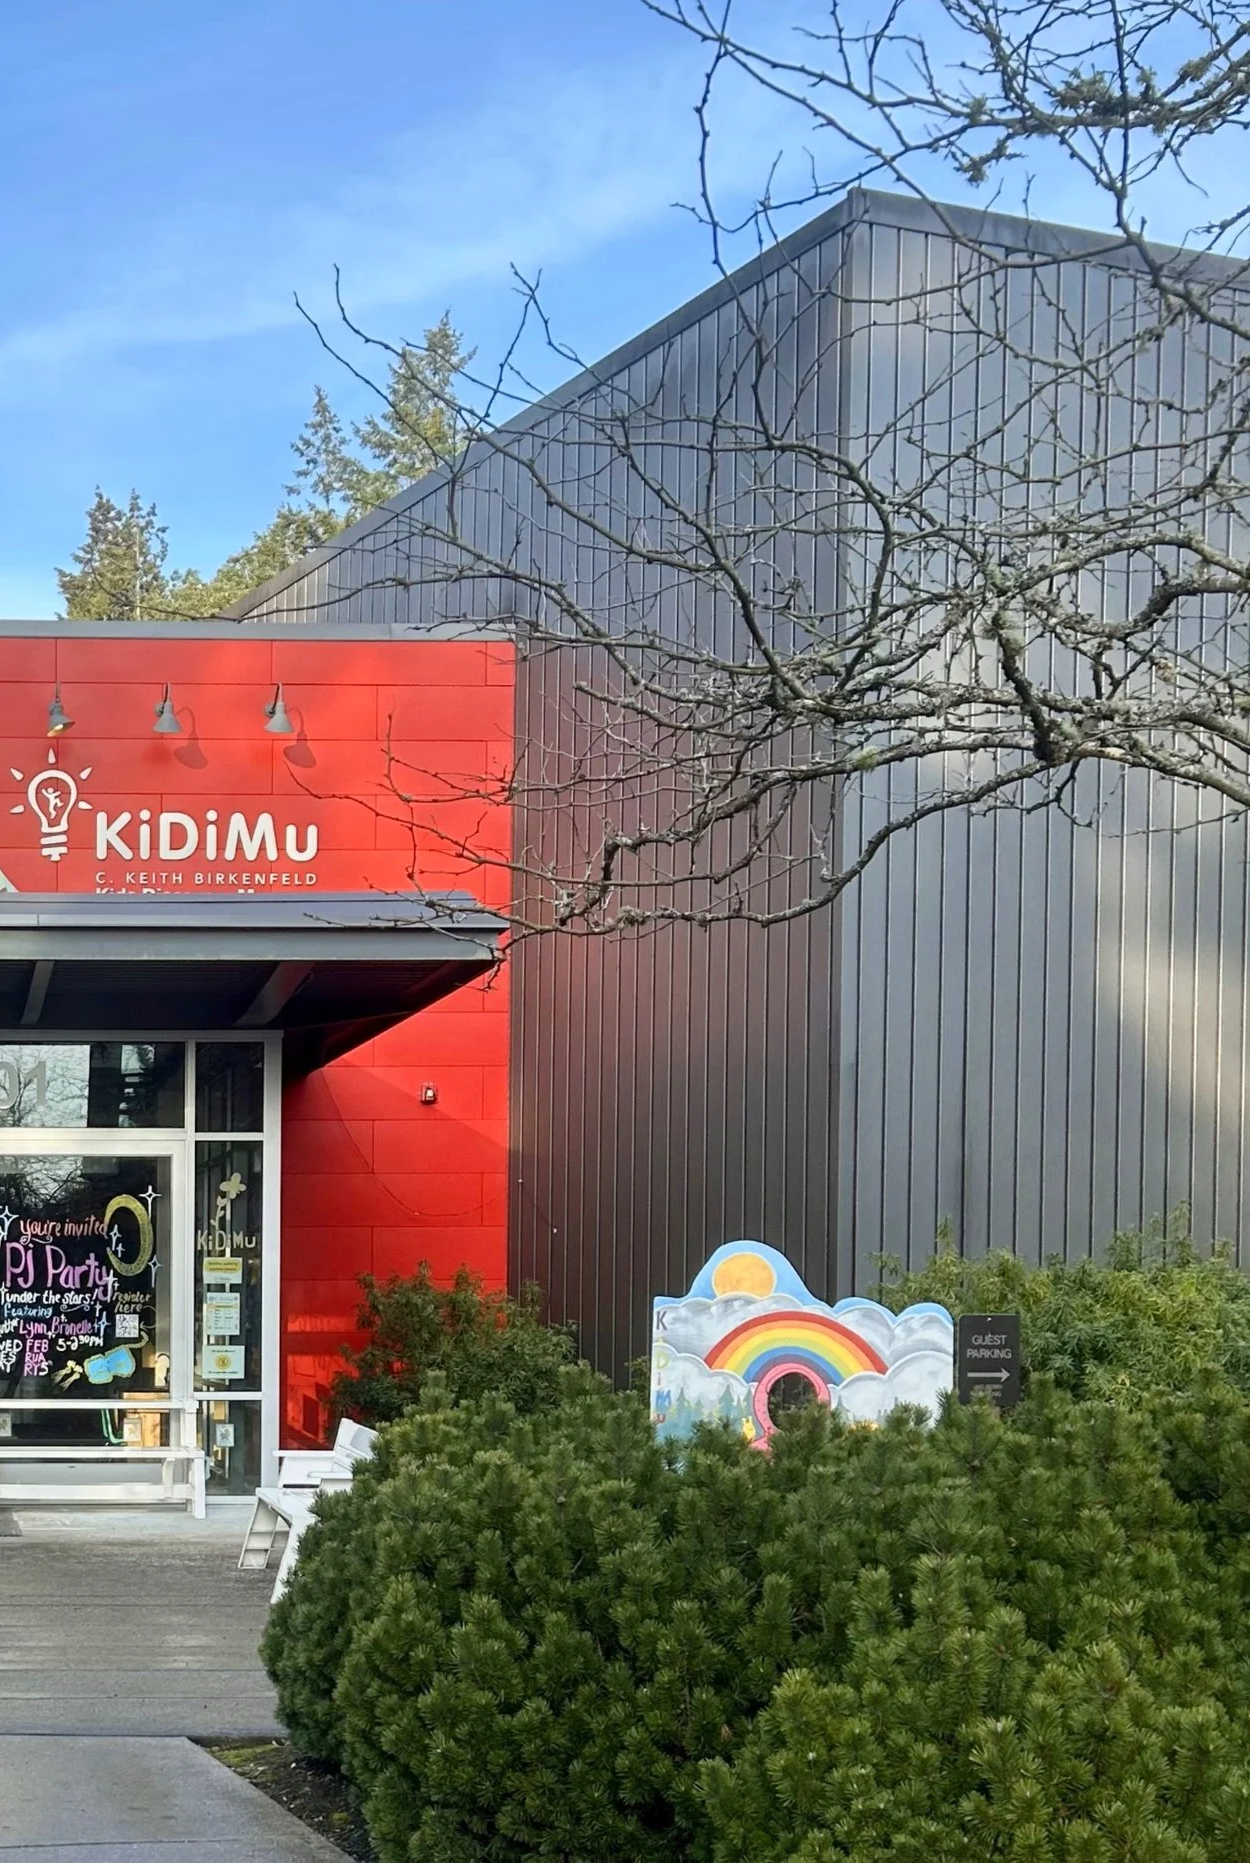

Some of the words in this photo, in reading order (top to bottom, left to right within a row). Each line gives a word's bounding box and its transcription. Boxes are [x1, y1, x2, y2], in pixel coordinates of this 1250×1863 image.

[96, 809, 318, 862] KiDiMu
[95, 872, 113, 885] C.
[126, 872, 183, 885] KEITH
[195, 872, 318, 885] BIRKENFELD
[197, 1230, 256, 1250] KiDiMu
[45, 1245, 112, 1301] Party
[6, 1291, 40, 1303] under
[42, 1290, 61, 1304] the
[62, 1289, 98, 1305] stars!
[112, 1289, 152, 1304] register
[114, 1302, 143, 1313] here
[19, 1319, 48, 1339] Lynn
[26, 1339, 49, 1352] FEB
[971, 1333, 1007, 1345] GUEST
[25, 1352, 46, 1363] RUA
[966, 1348, 1012, 1359] PARKING
